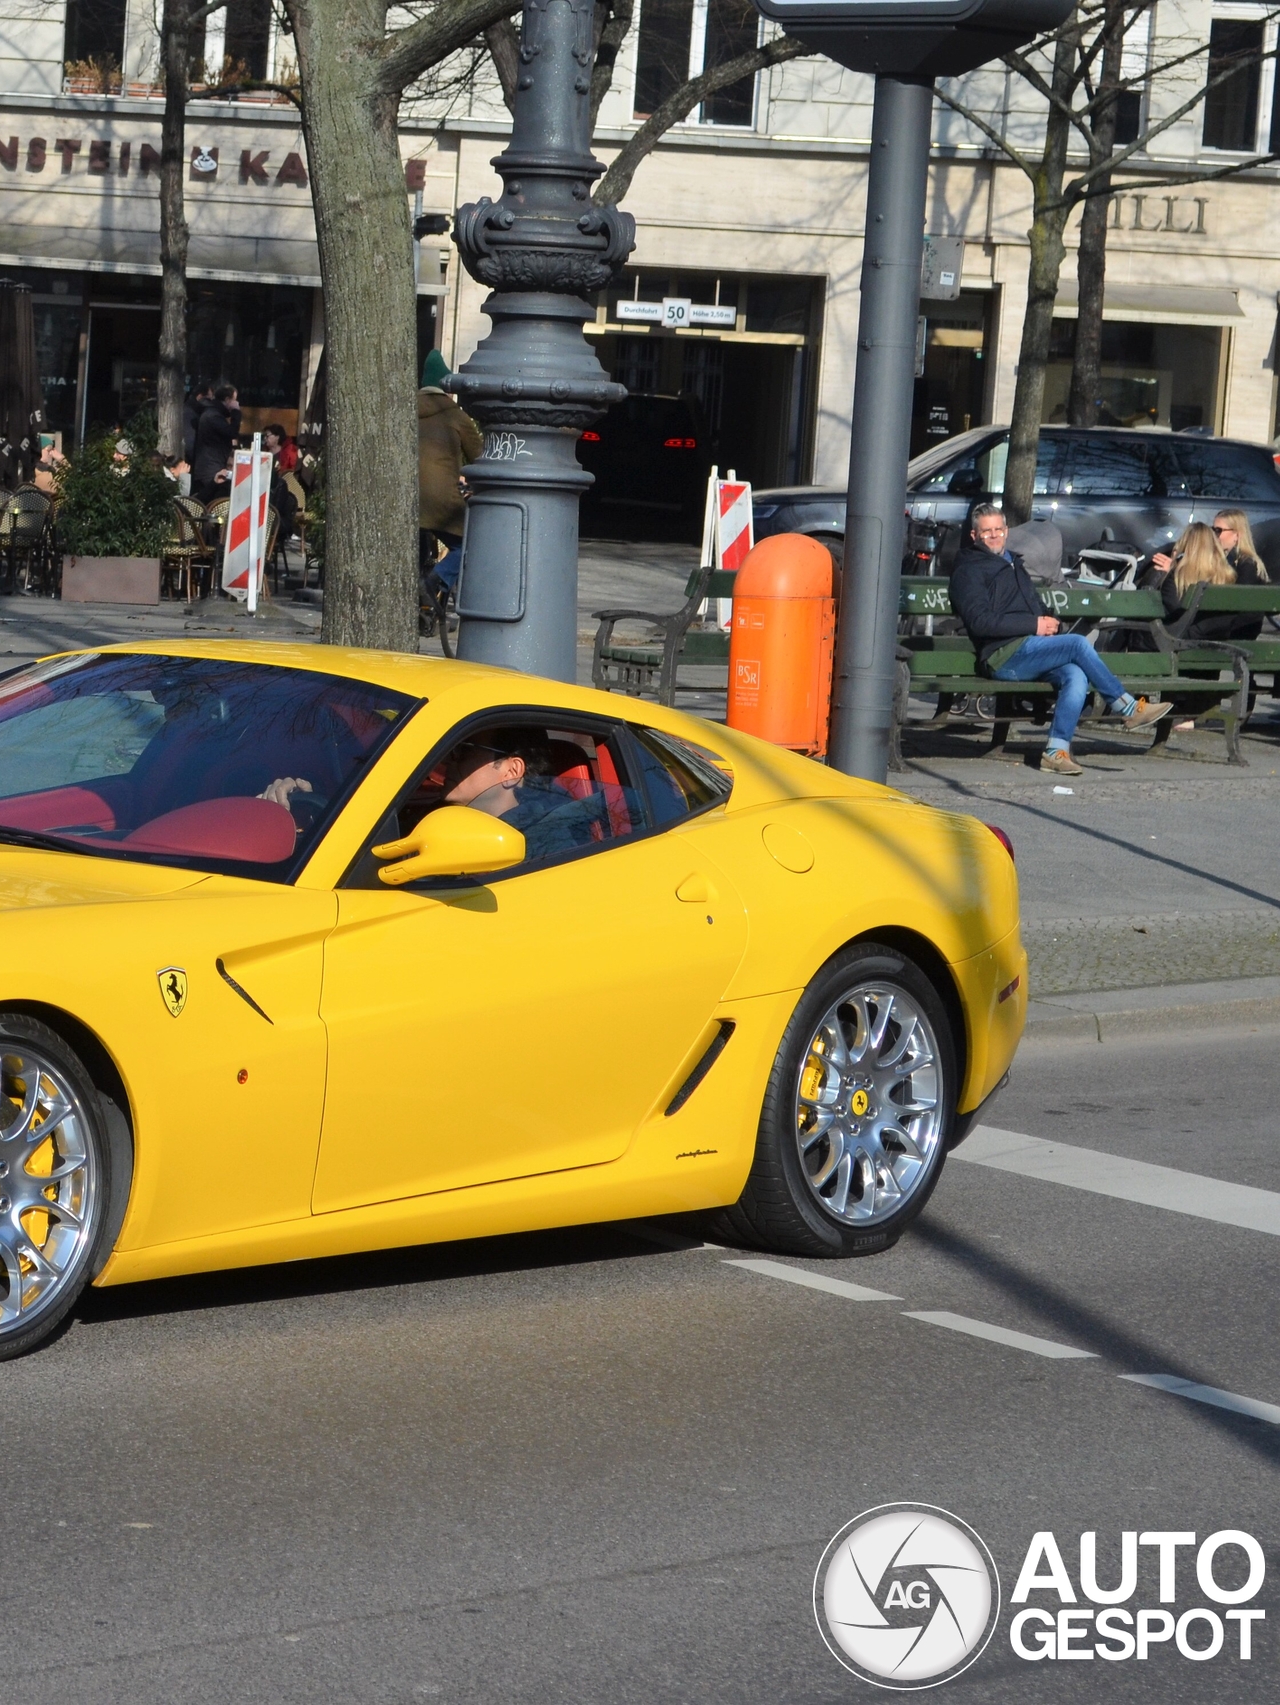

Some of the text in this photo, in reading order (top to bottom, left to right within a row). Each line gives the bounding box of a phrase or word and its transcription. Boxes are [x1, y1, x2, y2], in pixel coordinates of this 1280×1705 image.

[239, 149, 428, 192] KAE
[1075, 193, 1210, 234] ILLI
[624, 306, 658, 315] Durchfahrt
[667, 306, 685, 319] 50
[692, 310, 709, 318] Höhe
[738, 665, 757, 684] BSR
